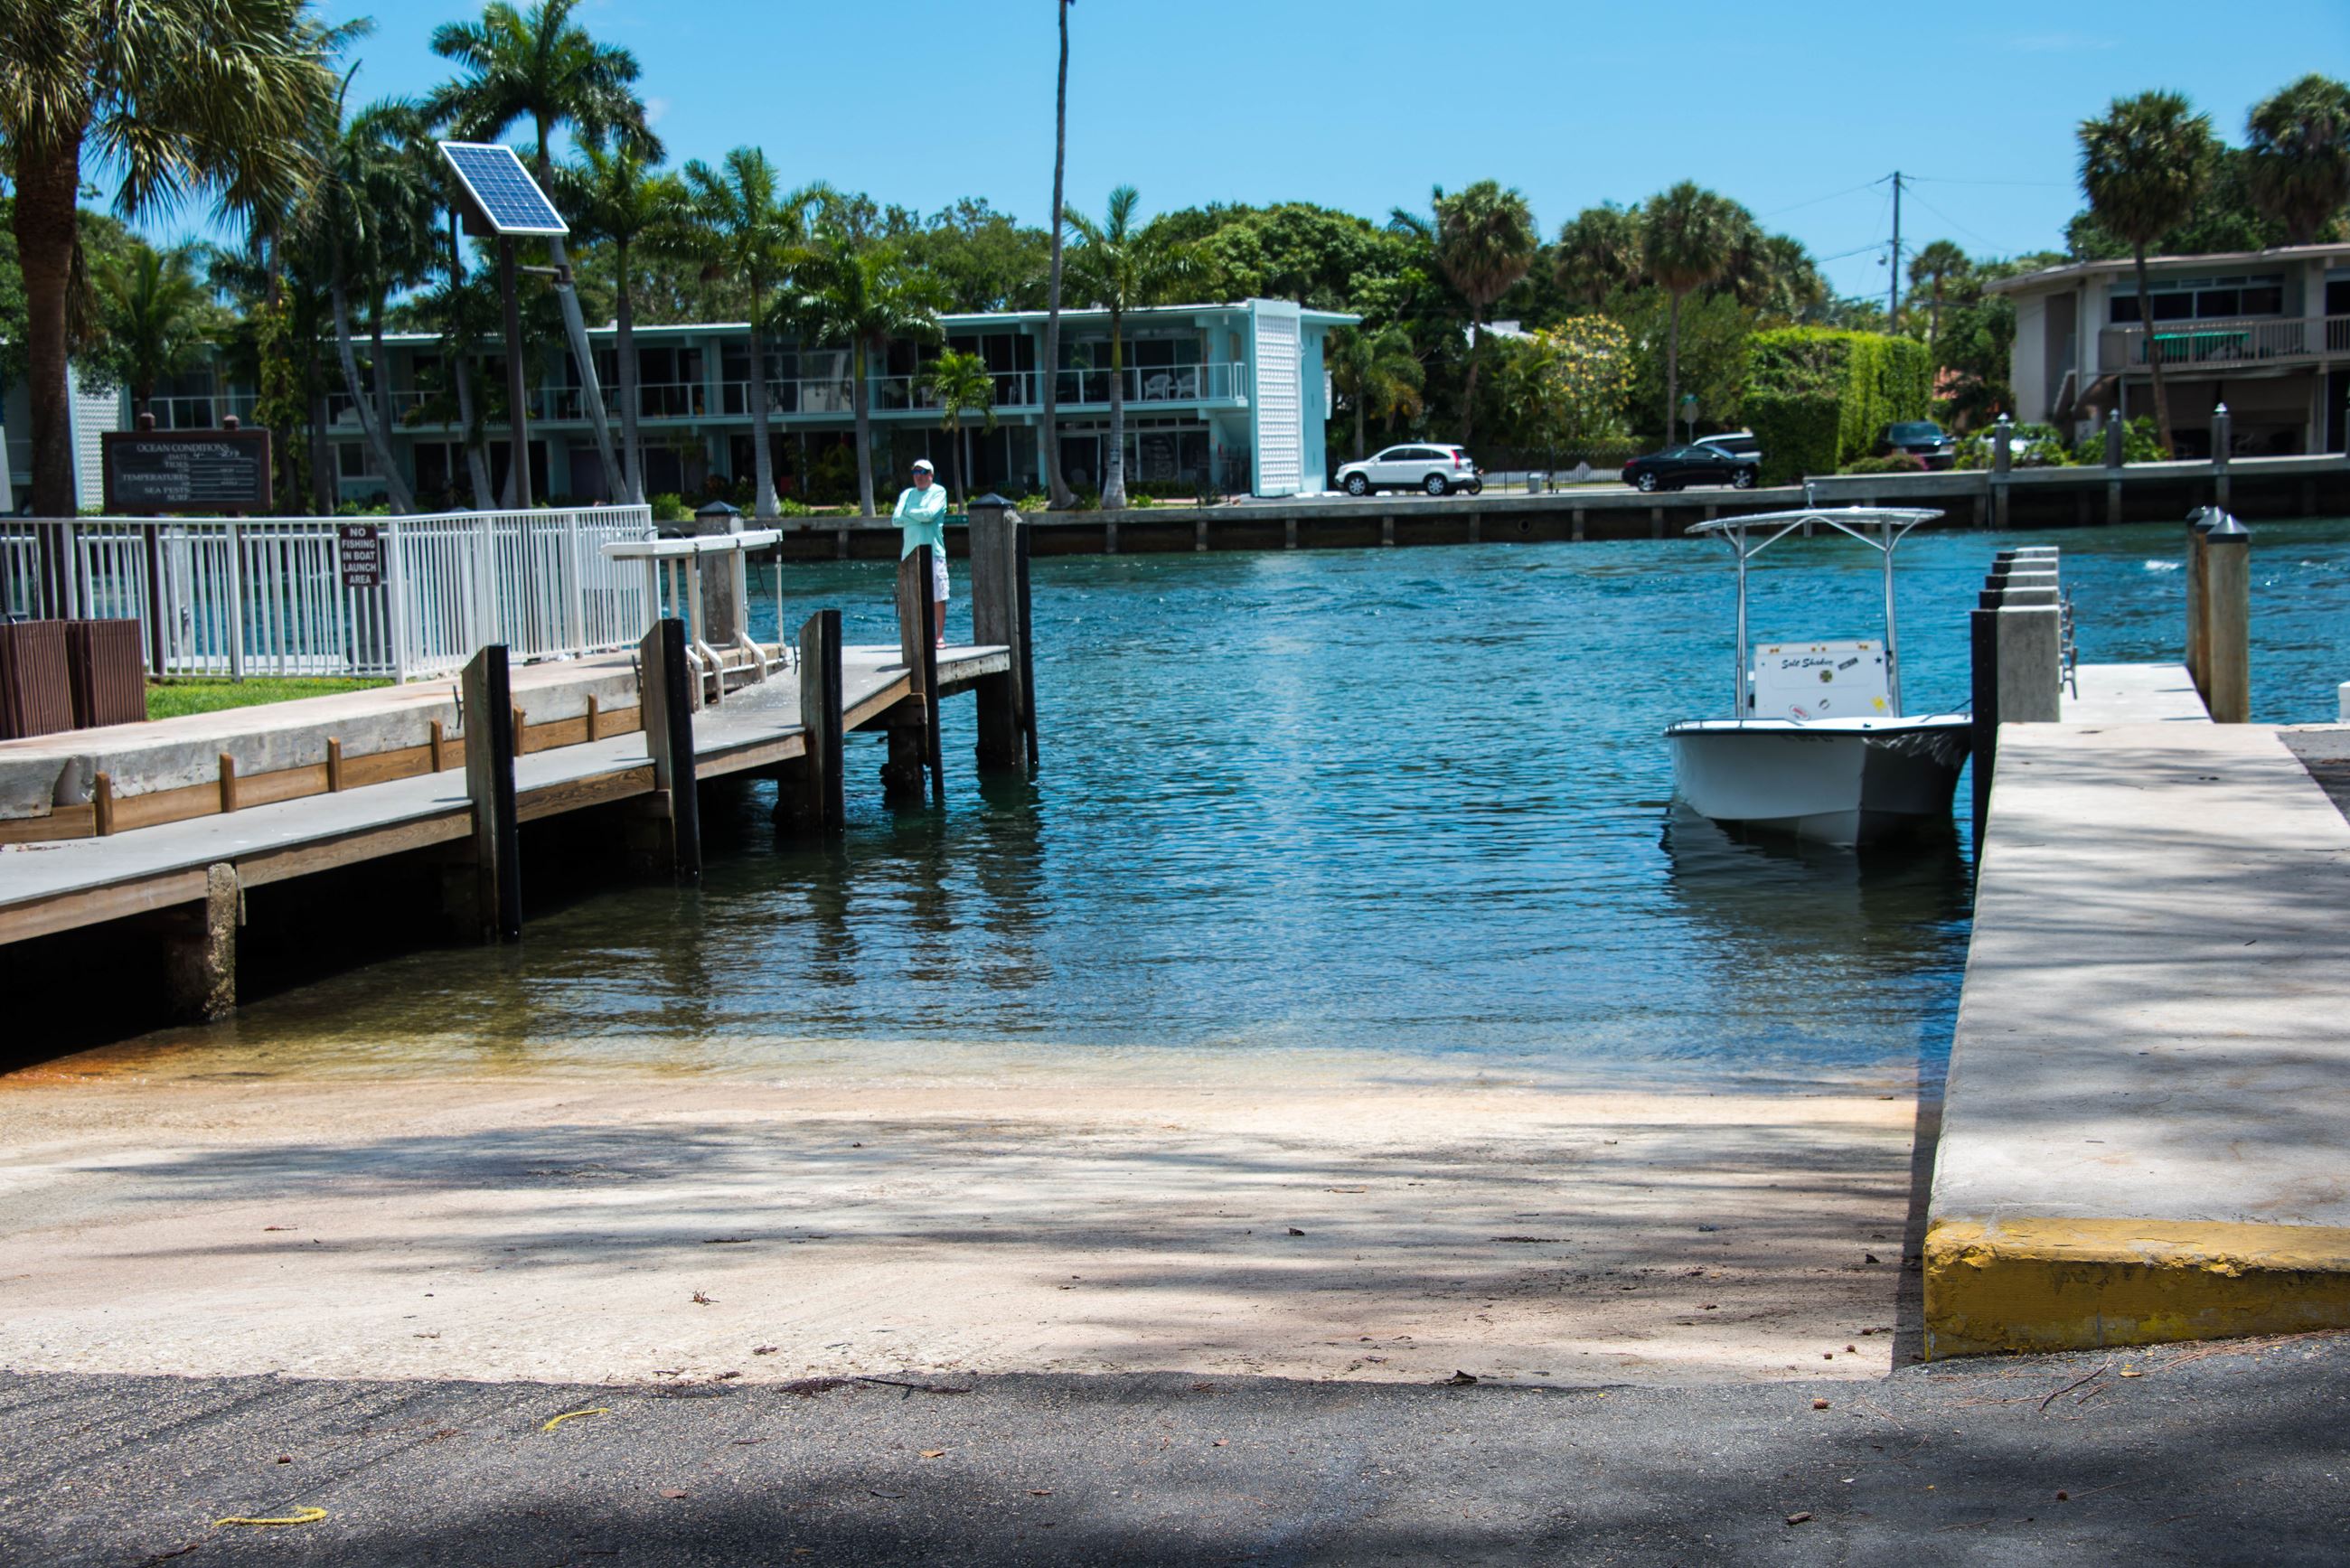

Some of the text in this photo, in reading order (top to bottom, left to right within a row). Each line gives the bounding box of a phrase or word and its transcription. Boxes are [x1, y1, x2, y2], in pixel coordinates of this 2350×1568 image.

[136, 443, 230, 453] OCEAN CONDITIONS
[350, 527, 367, 537] NO
[342, 539, 376, 549] FISHING
[343, 550, 376, 560] IN BOAT
[343, 562, 377, 572] LAUNCH
[349, 574, 372, 585] AREA
[1781, 659, 1800, 670] Salt
[1801, 658, 1834, 668] Shaker
